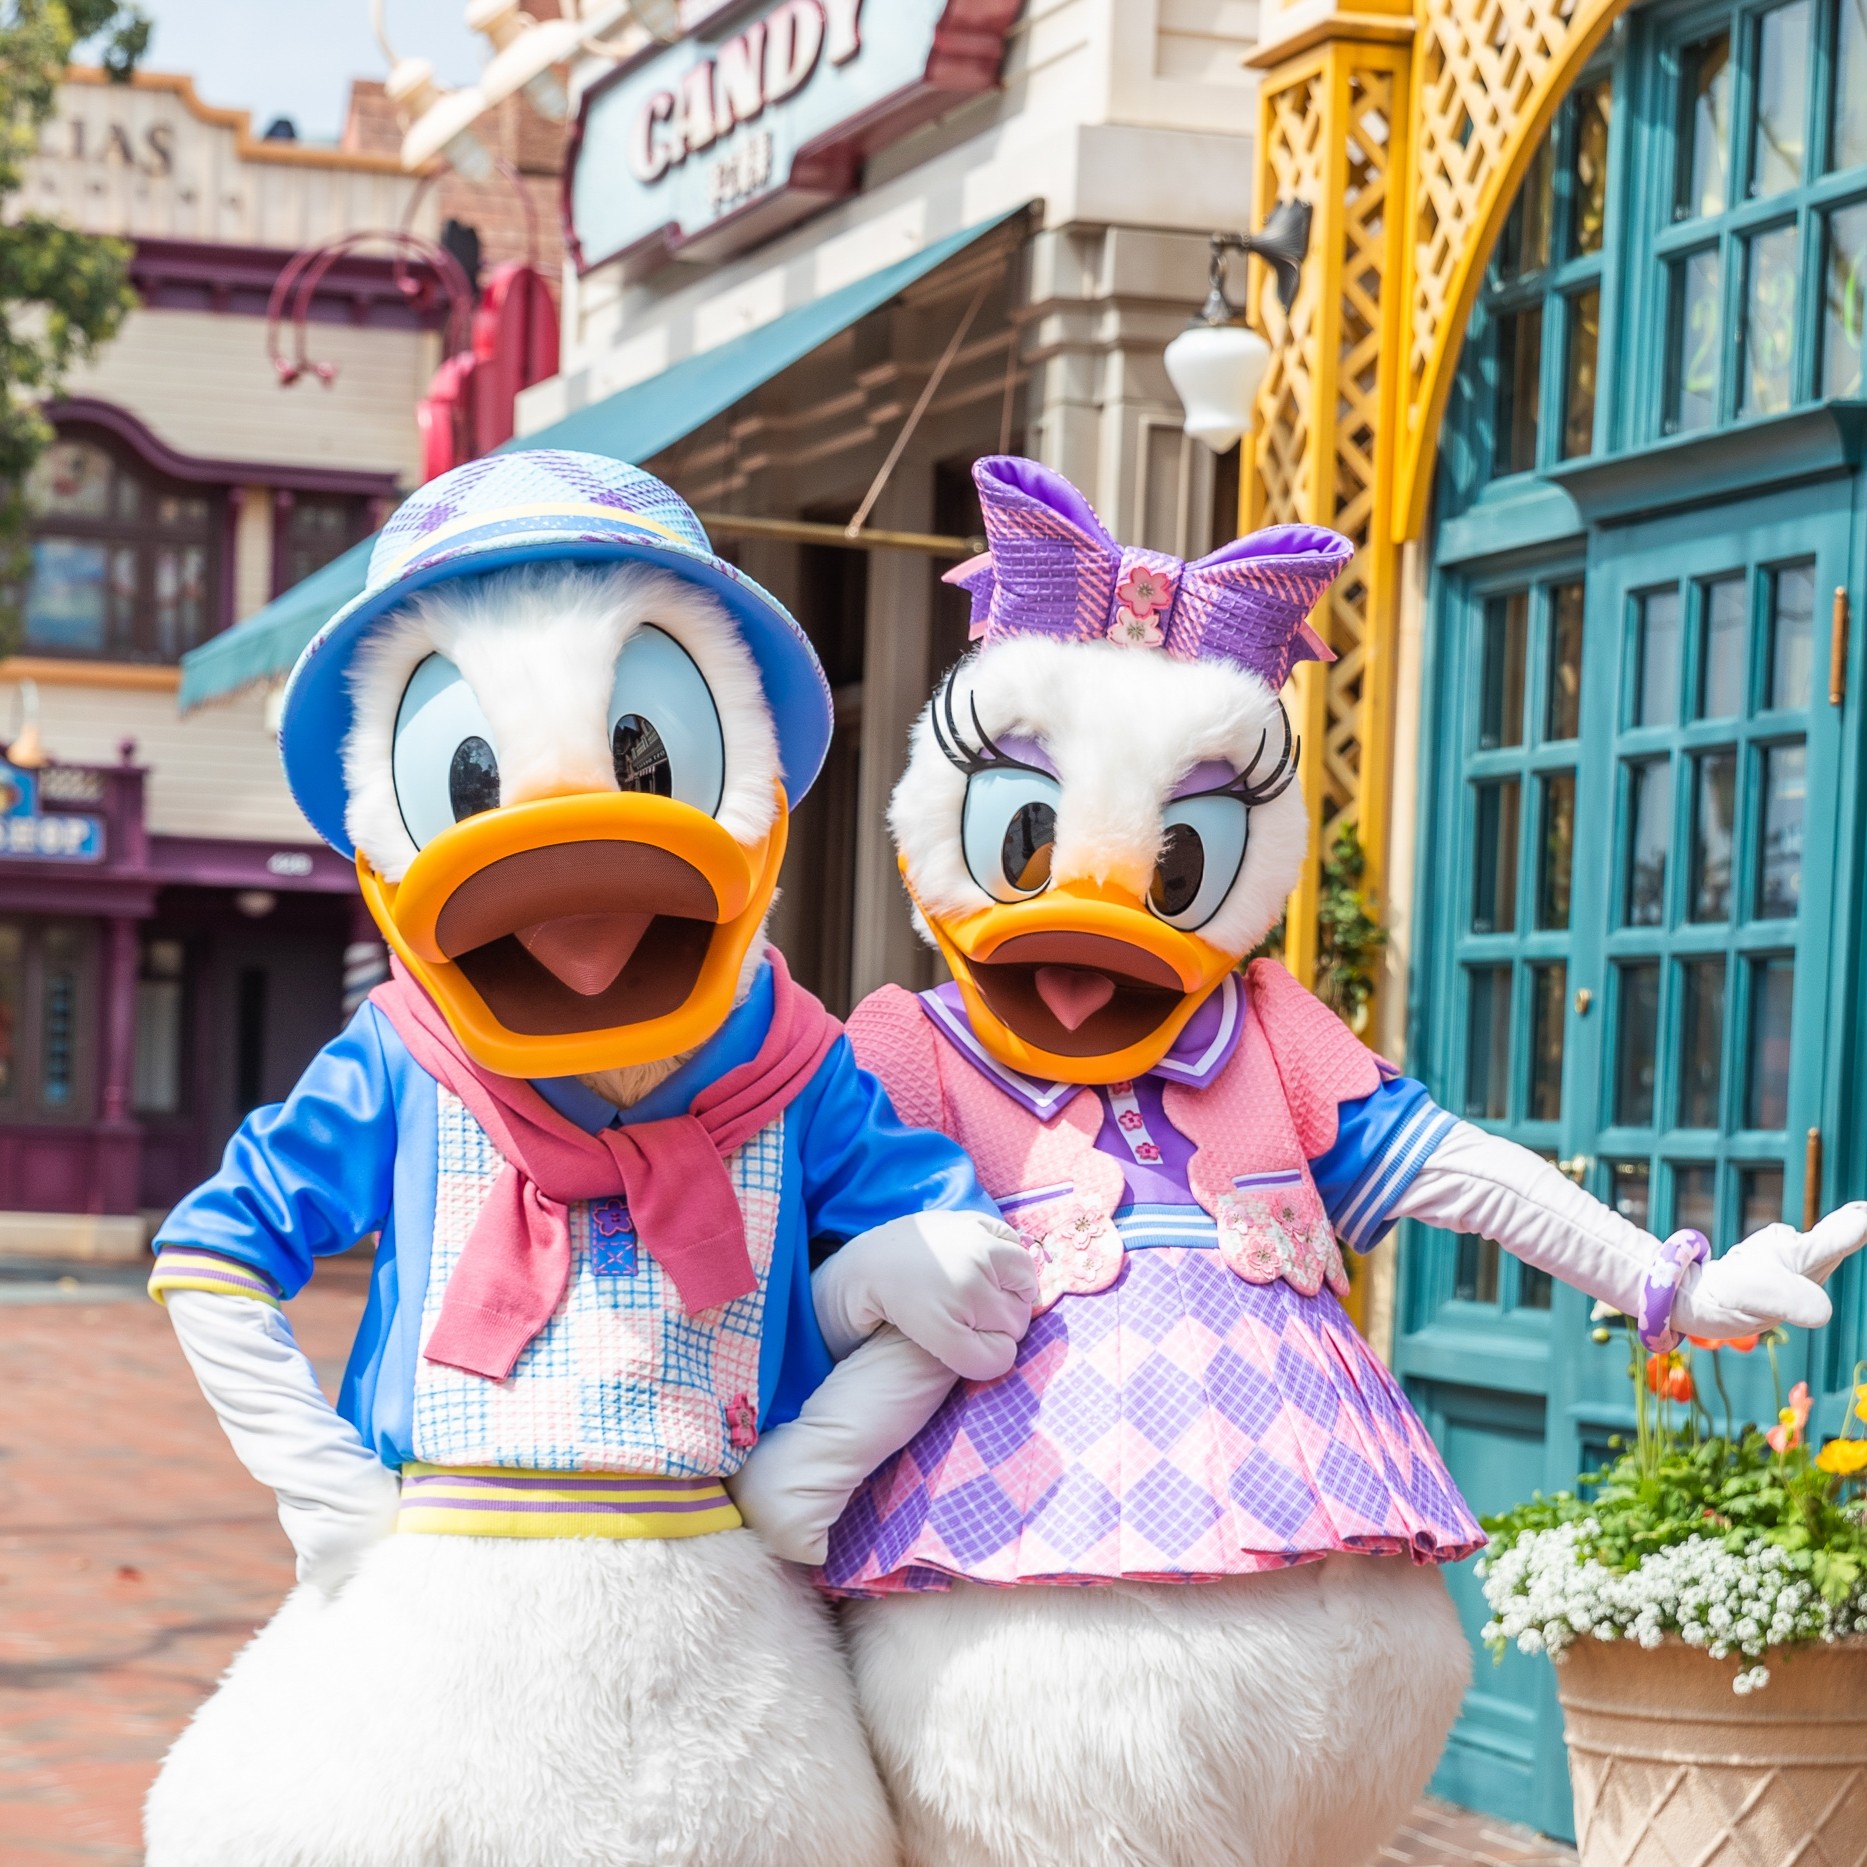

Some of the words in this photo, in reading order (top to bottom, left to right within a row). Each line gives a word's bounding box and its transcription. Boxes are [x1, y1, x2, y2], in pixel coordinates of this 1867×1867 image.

[629, 0, 862, 186] CANDY
[42, 116, 175, 179] IAS
[0, 816, 90, 855] HOP
